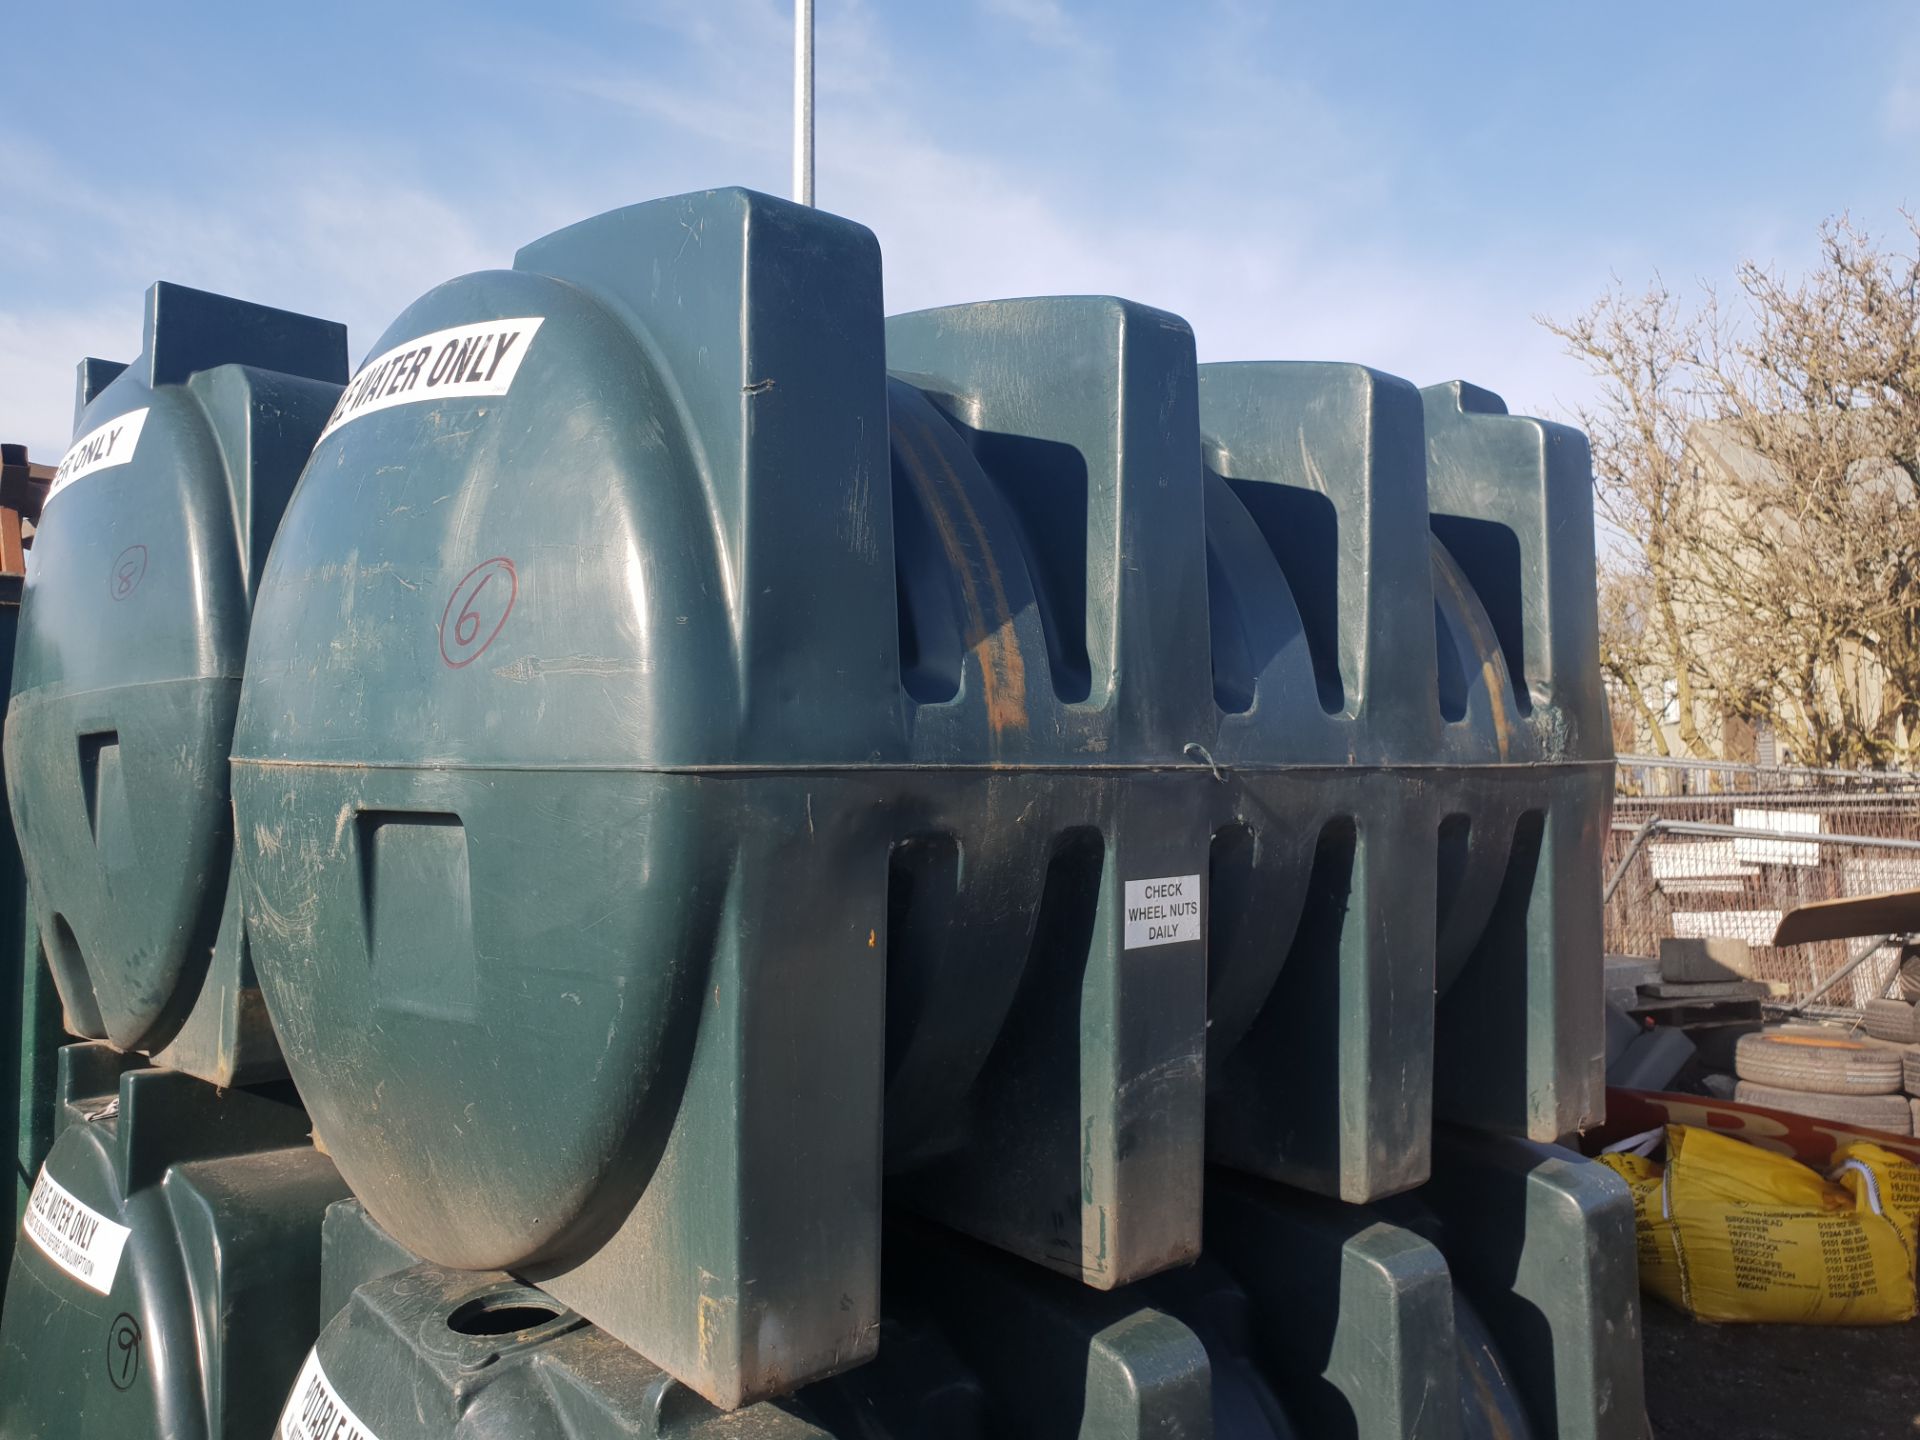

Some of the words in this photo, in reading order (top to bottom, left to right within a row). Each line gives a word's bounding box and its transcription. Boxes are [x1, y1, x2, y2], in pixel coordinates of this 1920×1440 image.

[355, 346, 432, 409] WATER
[426, 331, 520, 388] ONLY
[73, 426, 123, 473] ONLY
[1145, 883, 1182, 899] CHECK
[1128, 905, 1166, 921] WHEEL
[1170, 902, 1197, 917] NUTS
[1149, 924, 1179, 940] DAILY
[46, 1189, 75, 1236] WATER
[69, 1209, 99, 1251] ONLY
